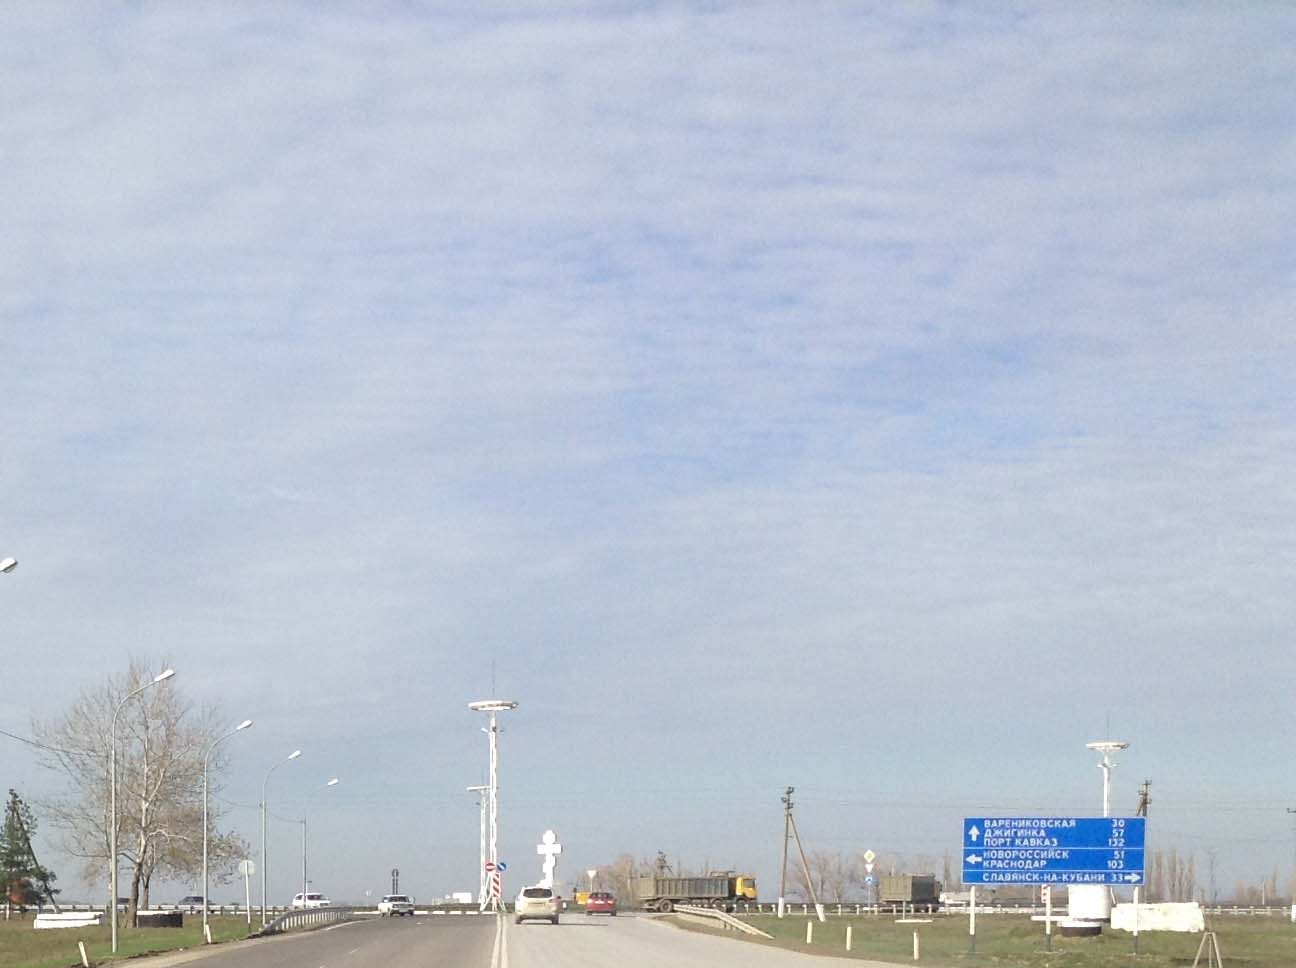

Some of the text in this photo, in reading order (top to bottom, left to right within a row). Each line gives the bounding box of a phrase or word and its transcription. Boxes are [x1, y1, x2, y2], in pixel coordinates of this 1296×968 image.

[983, 819, 1125, 828] ВАРЕНИКОВСКАЯ 30
[983, 829, 1125, 838] ДЖИГИНКА 57
[983, 838, 1125, 847] ПОРТ КАВКАЗ 132
[983, 849, 1125, 859] НОВОРОССИЙСК 51
[983, 860, 1124, 870] КРАСНОДАР 103
[982, 872, 1124, 882] СЛАВЯНСК-НА-КУБАНИ 33
